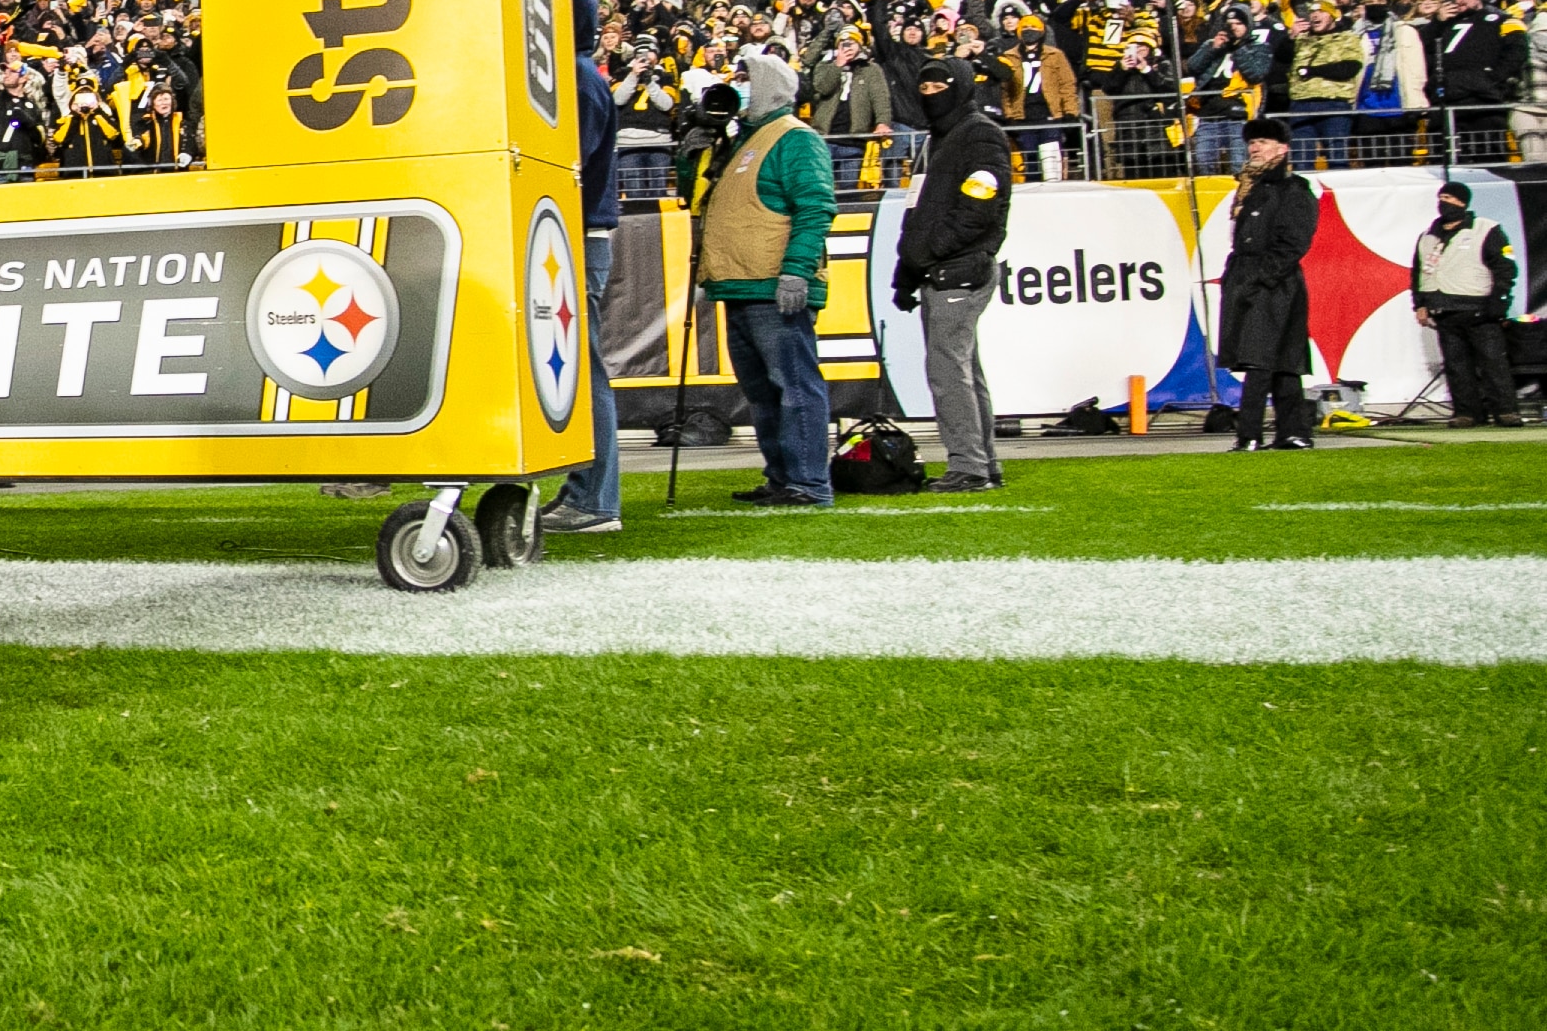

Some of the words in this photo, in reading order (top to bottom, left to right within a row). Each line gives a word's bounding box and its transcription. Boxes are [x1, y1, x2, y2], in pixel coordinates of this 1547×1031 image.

[1444, 24, 1473, 53] 7
[44, 252, 225, 290] NATION
[999, 249, 1165, 306] teelers
[267, 311, 316, 326] Steelers
